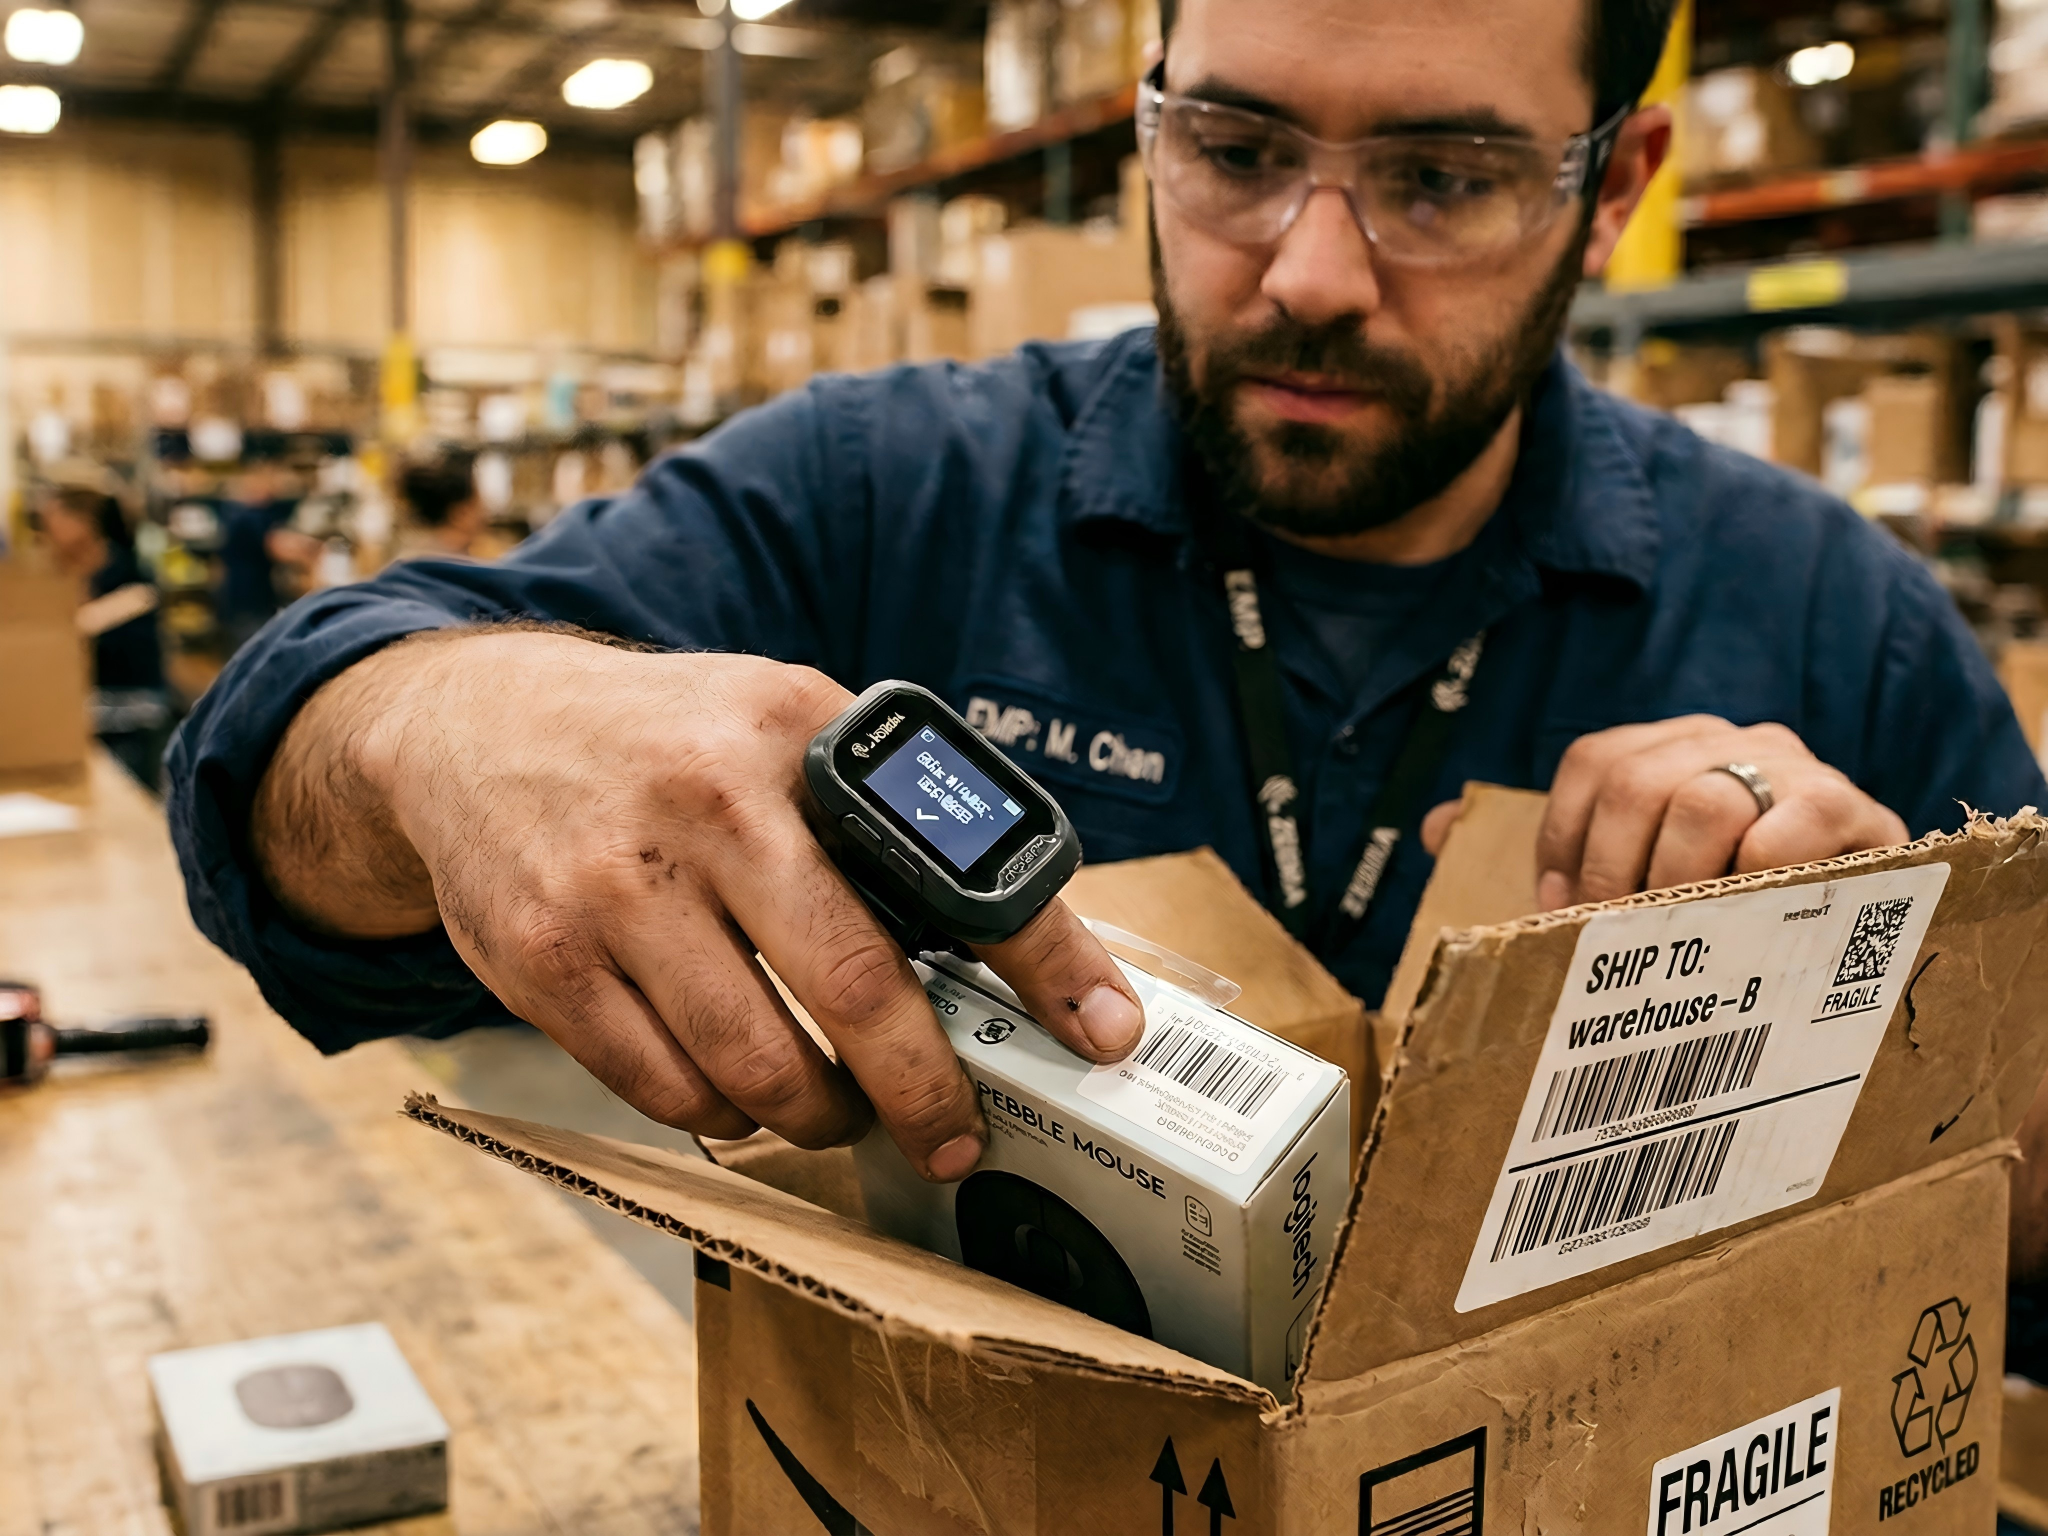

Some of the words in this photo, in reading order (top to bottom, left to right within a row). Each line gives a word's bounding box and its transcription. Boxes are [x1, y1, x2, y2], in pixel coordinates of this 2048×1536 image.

[1044, 718, 1079, 764] M.
[1586, 945, 1659, 995] SHIP
[1667, 936, 1711, 980] TO:
[1821, 983, 1881, 1014] FRAGILE
[976, 1079, 1064, 1144] PEBBLE
[1073, 1131, 1167, 1200] MOUSE
[1282, 1151, 1319, 1301] logitech
[1657, 1406, 1831, 1536] FRAGILE
[1879, 1441, 1980, 1522] RECYCLED
